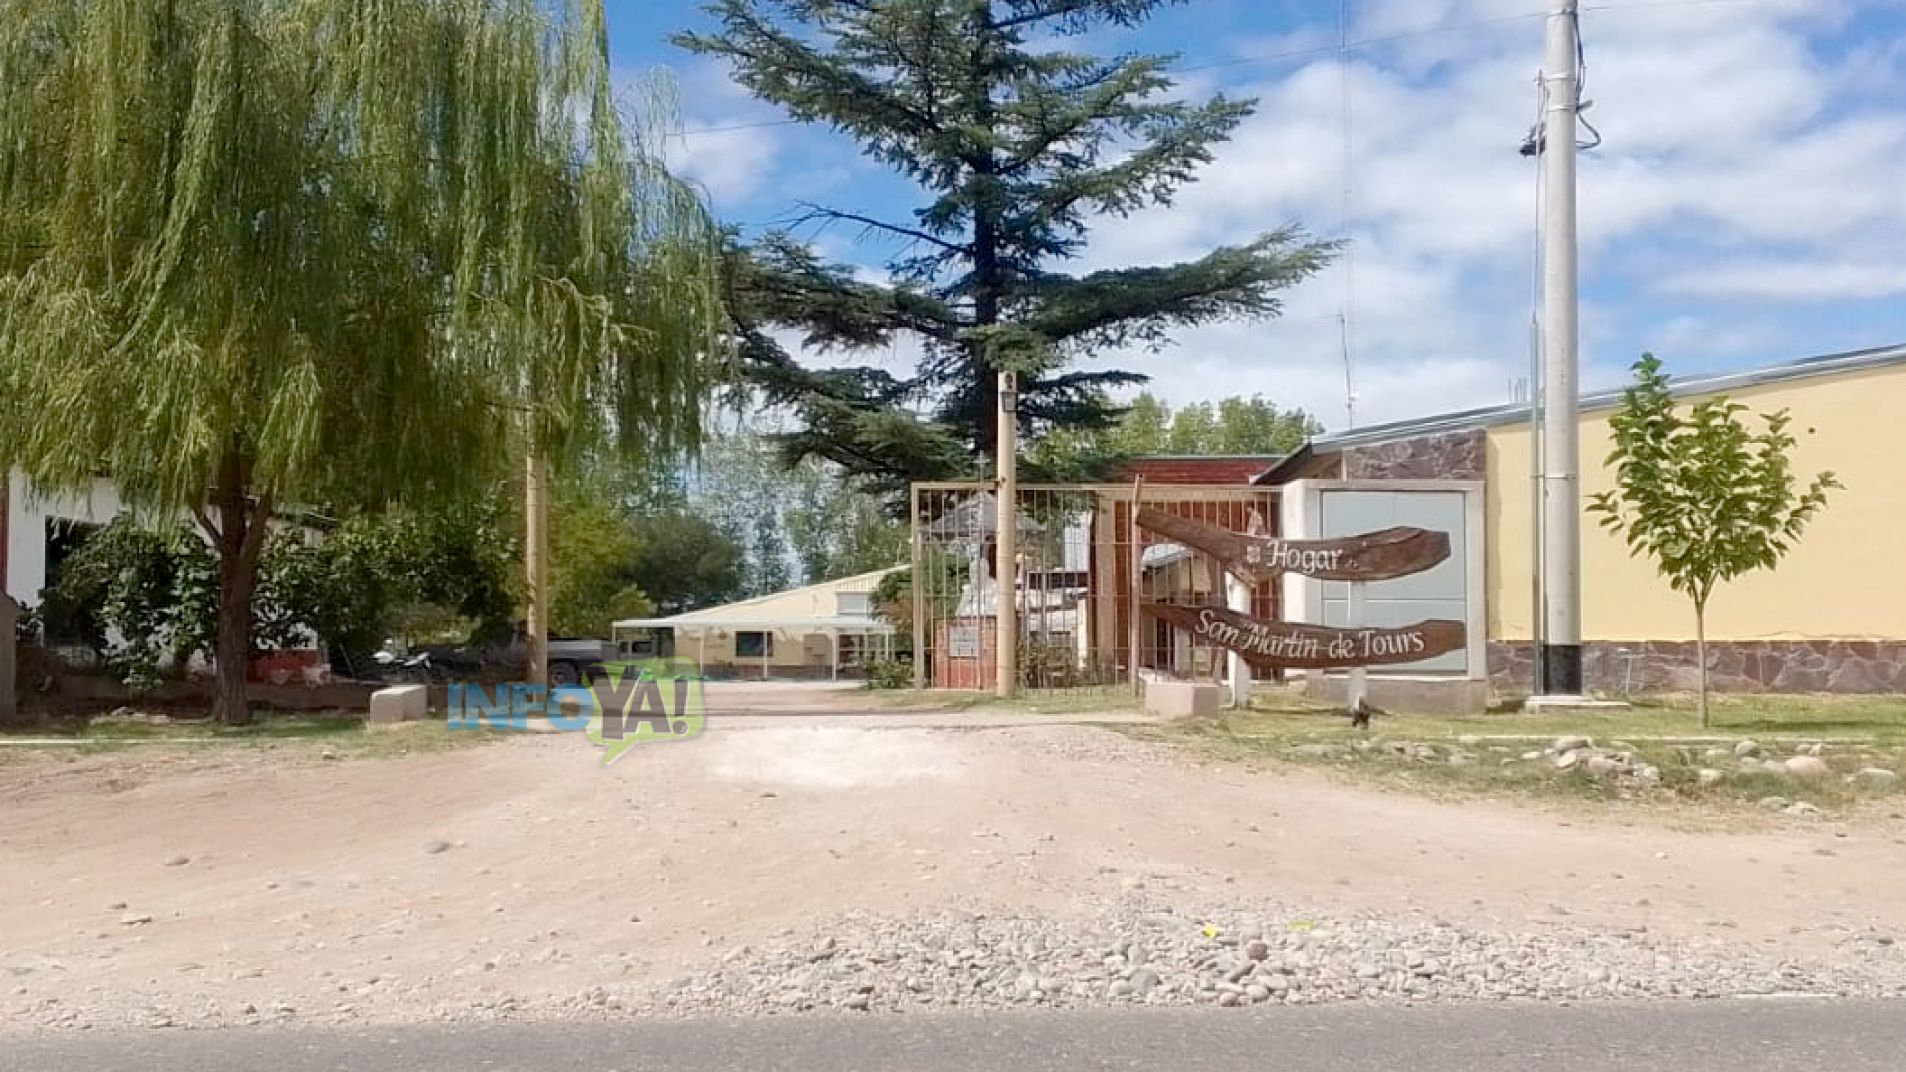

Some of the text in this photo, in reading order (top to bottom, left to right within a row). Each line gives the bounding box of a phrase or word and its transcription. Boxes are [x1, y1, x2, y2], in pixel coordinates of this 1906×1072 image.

[1266, 540, 1343, 576] Hogar
[1195, 609, 1239, 646] San
[1329, 632, 1356, 659] de
[1359, 630, 1425, 657] Tours
